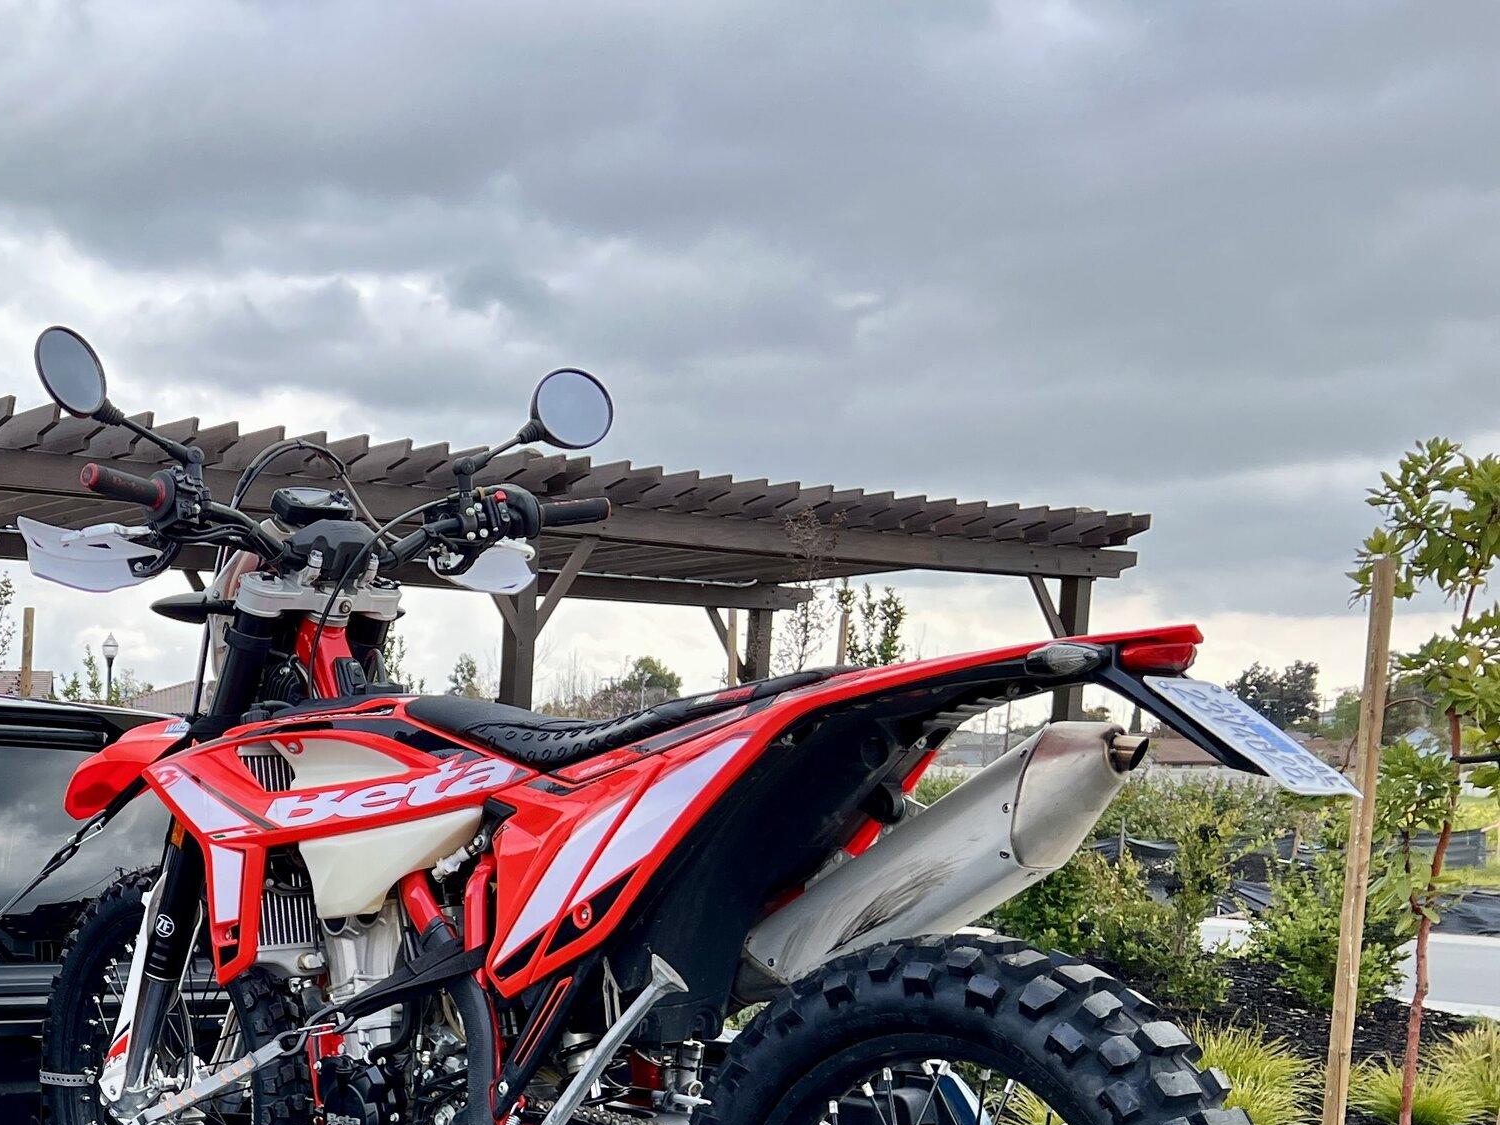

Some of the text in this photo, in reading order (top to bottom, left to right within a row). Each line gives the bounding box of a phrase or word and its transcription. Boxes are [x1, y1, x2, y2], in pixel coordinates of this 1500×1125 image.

[265, 756, 516, 827] Beta
[156, 914, 175, 938] ZF
[326, 1112, 361, 1125] Beta
